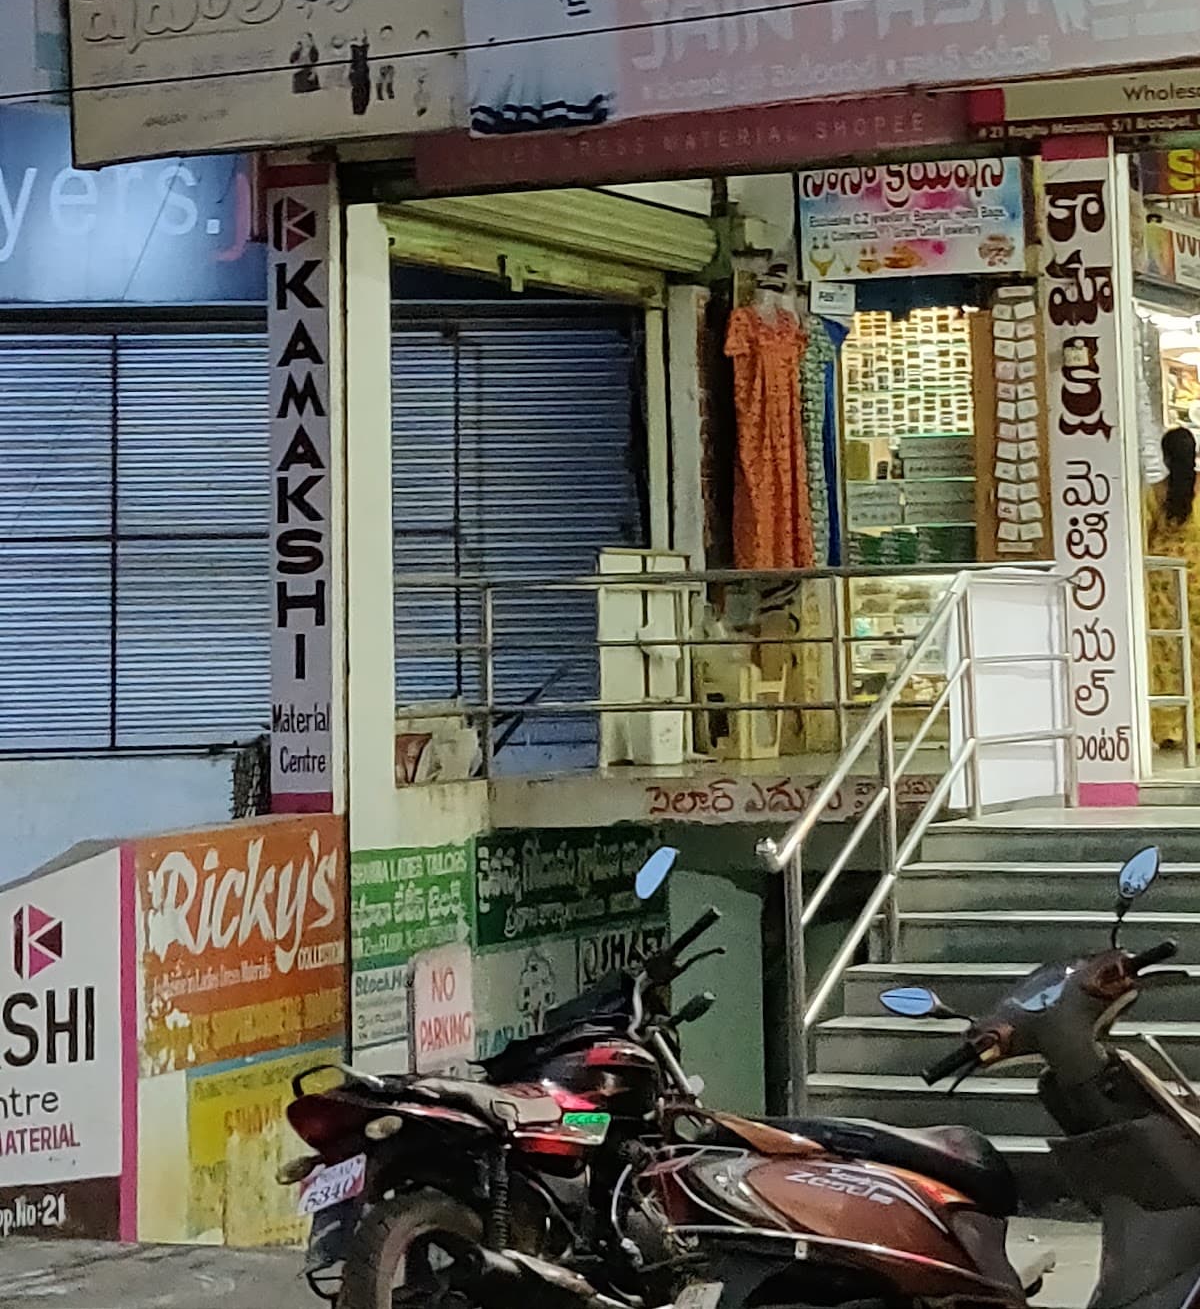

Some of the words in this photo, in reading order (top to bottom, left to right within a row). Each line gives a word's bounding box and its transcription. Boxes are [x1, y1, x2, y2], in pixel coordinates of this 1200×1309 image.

[814, 111, 925, 140] SHOPEE
[275, 259, 326, 681] KAMAKSHI
[271, 703, 331, 737] Material
[279, 746, 327, 777] Centre
[148, 829, 339, 974] Ricky's
[431, 966, 456, 1003] NO
[420, 1010, 472, 1052] PARKING
